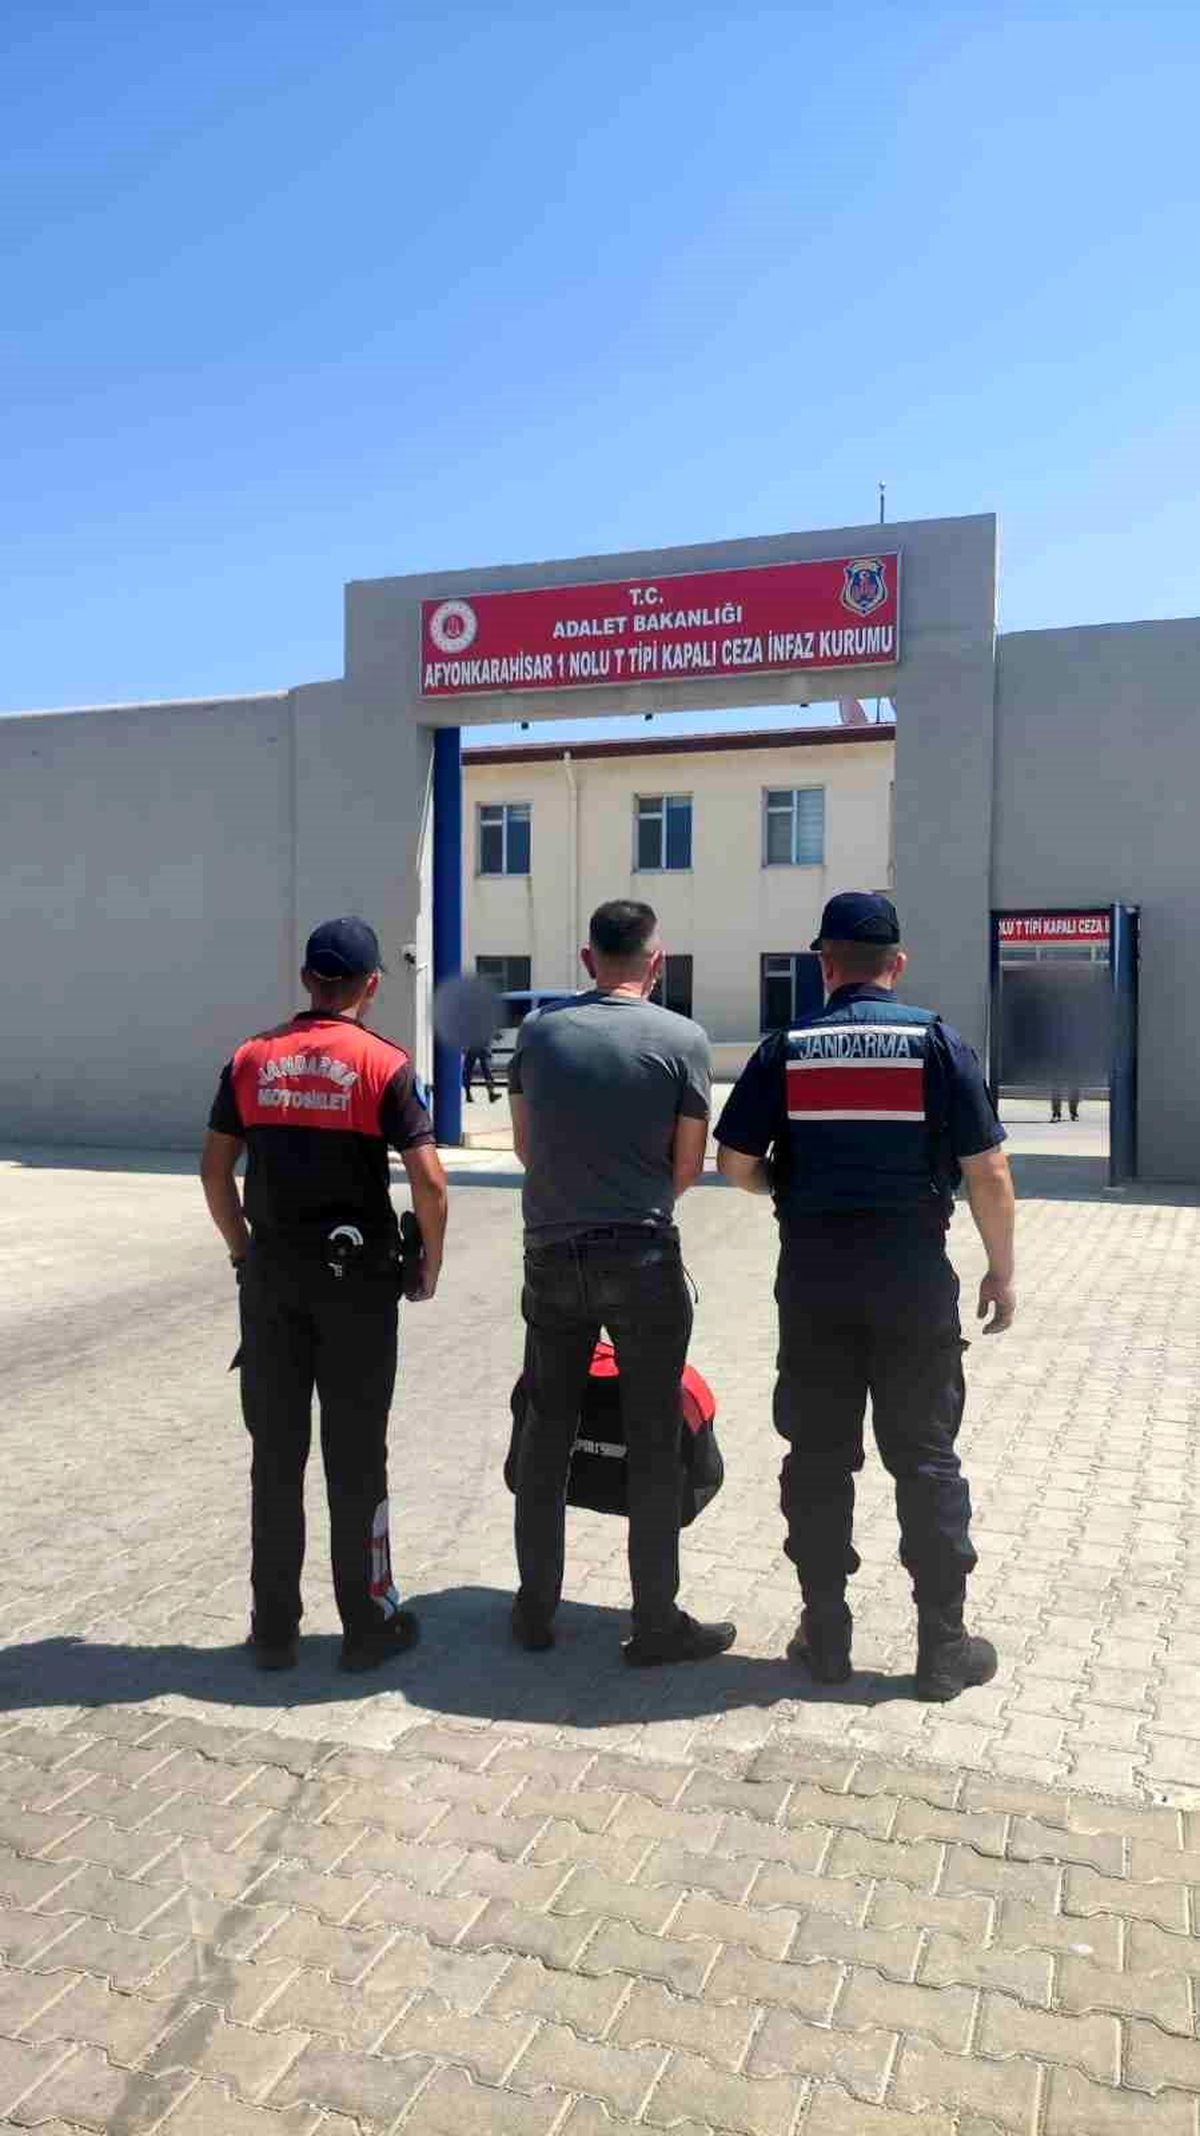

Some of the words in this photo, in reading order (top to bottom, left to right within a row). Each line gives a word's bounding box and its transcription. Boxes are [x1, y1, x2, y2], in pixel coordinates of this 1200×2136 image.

[629, 587, 664, 606] T.C.
[553, 616, 627, 638] ADALET
[633, 603, 743, 632] BAKANLIĞI
[424, 651, 553, 688] AFYONKARAHİSAR
[556, 656, 565, 677] 1
[569, 651, 610, 676] NOLU
[614, 648, 625, 674] T
[629, 640, 658, 673] TİPİ
[661, 640, 717, 671] KAPALI
[722, 636, 763, 665] CEZA
[768, 630, 814, 663] İNFAZ
[819, 625, 894, 658] KURUMU
[1016, 920, 1023, 935] T
[1079, 918, 1103, 934] CEZA
[800, 1034, 911, 1059] JANDARMA
[257, 1055, 359, 1087] JANDARMA
